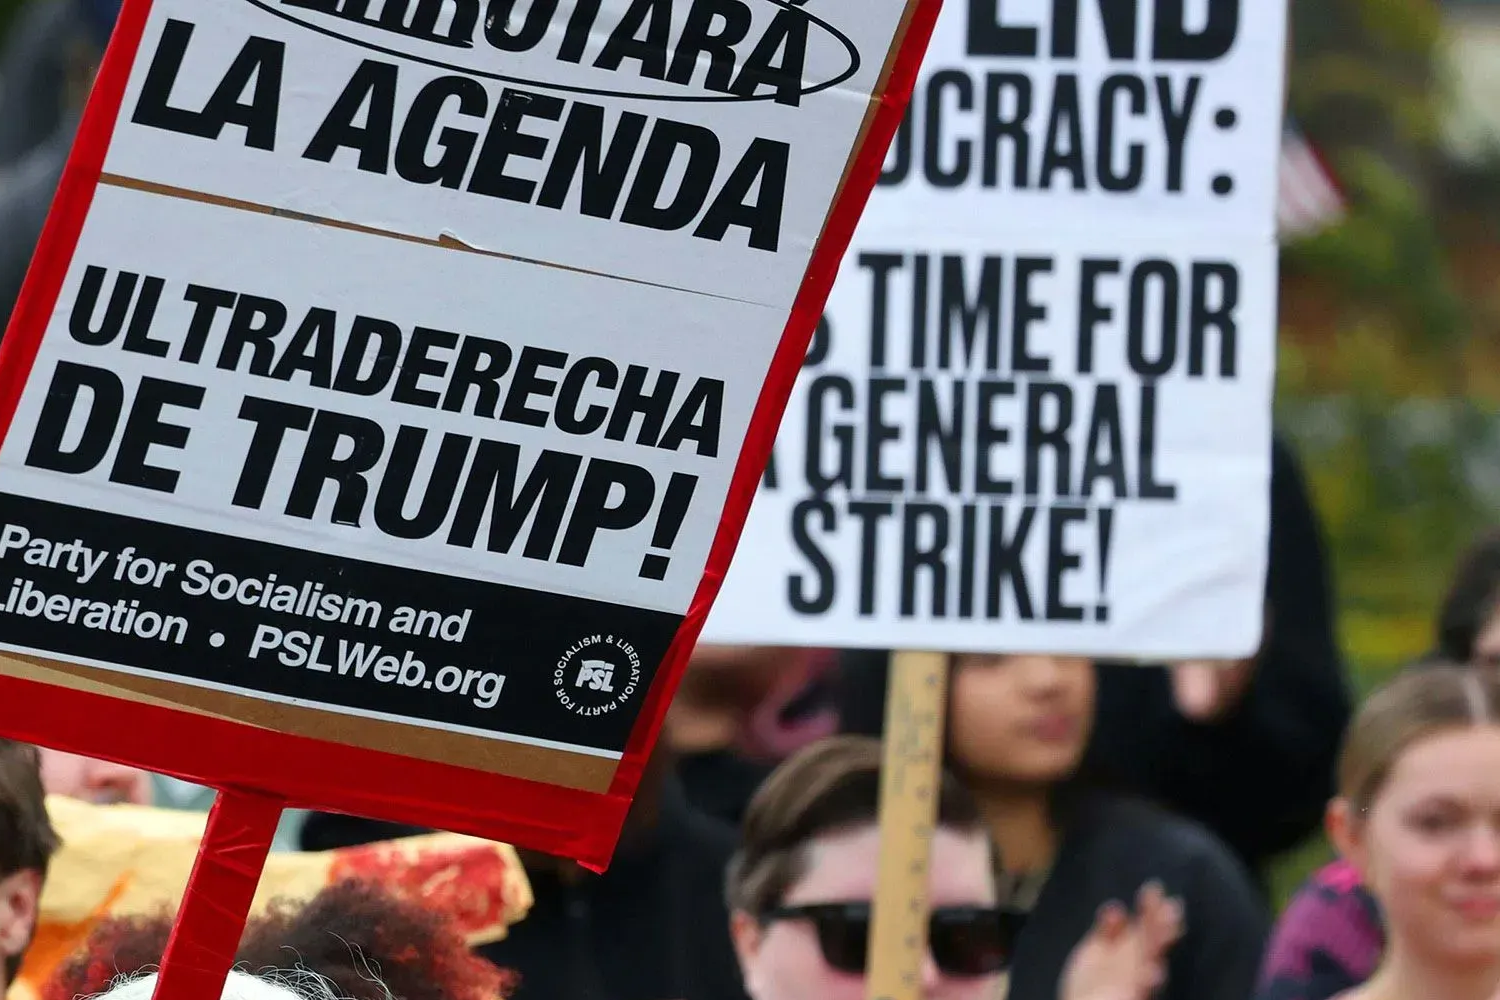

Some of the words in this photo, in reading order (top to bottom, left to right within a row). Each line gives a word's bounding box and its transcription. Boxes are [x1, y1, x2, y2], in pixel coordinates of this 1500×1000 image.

[131, 18, 286, 152] LA
[301, 59, 791, 252] AGENDA
[858, 253, 1055, 371] TIME
[1078, 259, 1239, 377] FOR
[68, 265, 725, 458] ULTRADERECHA
[24, 359, 206, 493] DE
[231, 395, 699, 581] TRUMP!
[805, 374, 1176, 498] GENERAL
[113, 546, 176, 588] for
[181, 559, 382, 628] Socialism
[389, 609, 473, 643] and
[787, 497, 1115, 623] STRIKE!
[248, 624, 506, 708] PSLWeb.org
[553, 634, 601, 686] SOCIALISM
[575, 662, 614, 692] PSL
[605, 635, 614, 644] &
[616, 638, 640, 703] LIBERATION
[556, 688, 576, 710] FOR
[576, 701, 617, 716] PARTY
